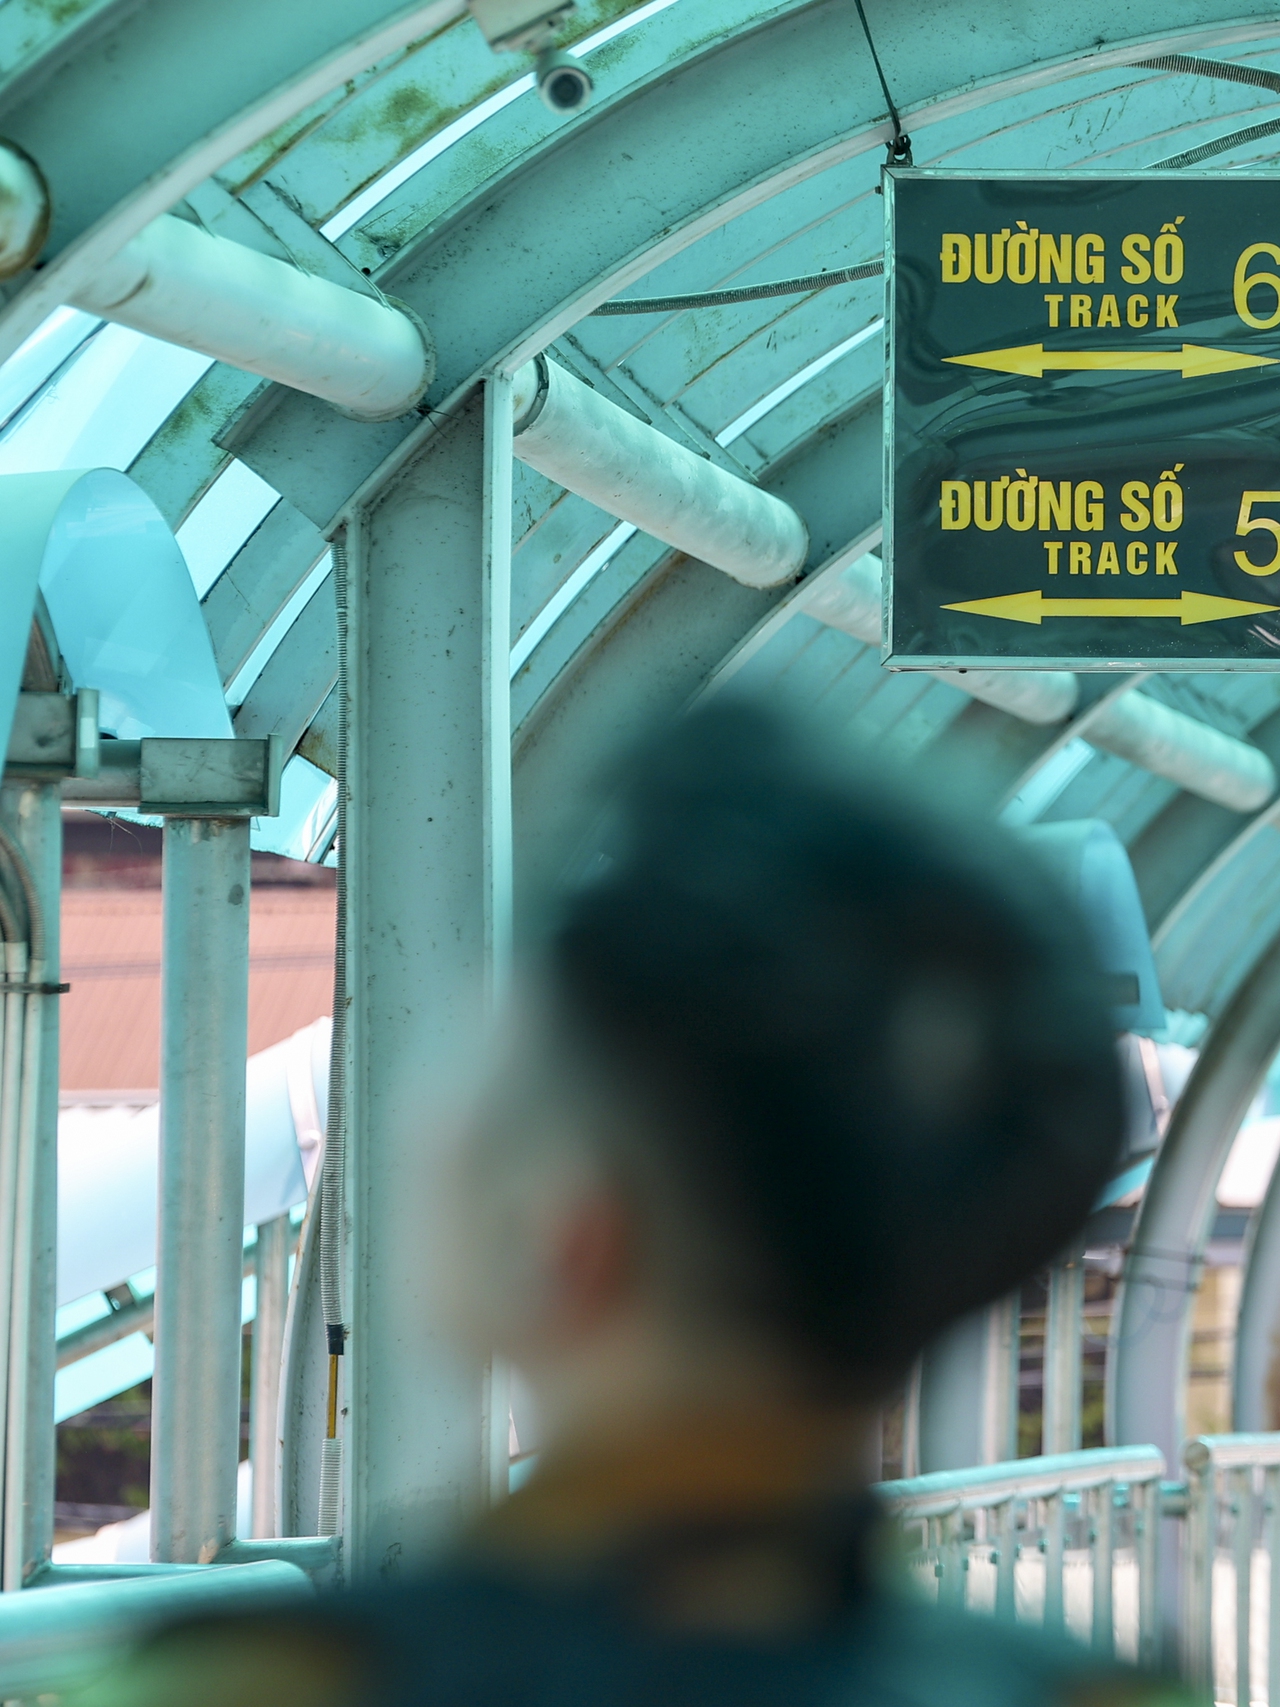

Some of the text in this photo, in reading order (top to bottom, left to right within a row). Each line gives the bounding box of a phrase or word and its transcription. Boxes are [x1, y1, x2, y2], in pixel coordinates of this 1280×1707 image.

[940, 216, 1186, 285] ĐƯỜNG SỐ
[1044, 294, 1180, 328] TRACK
[939, 463, 1185, 532] ĐƯỜNG SỐ
[1043, 541, 1179, 575] TRACK
